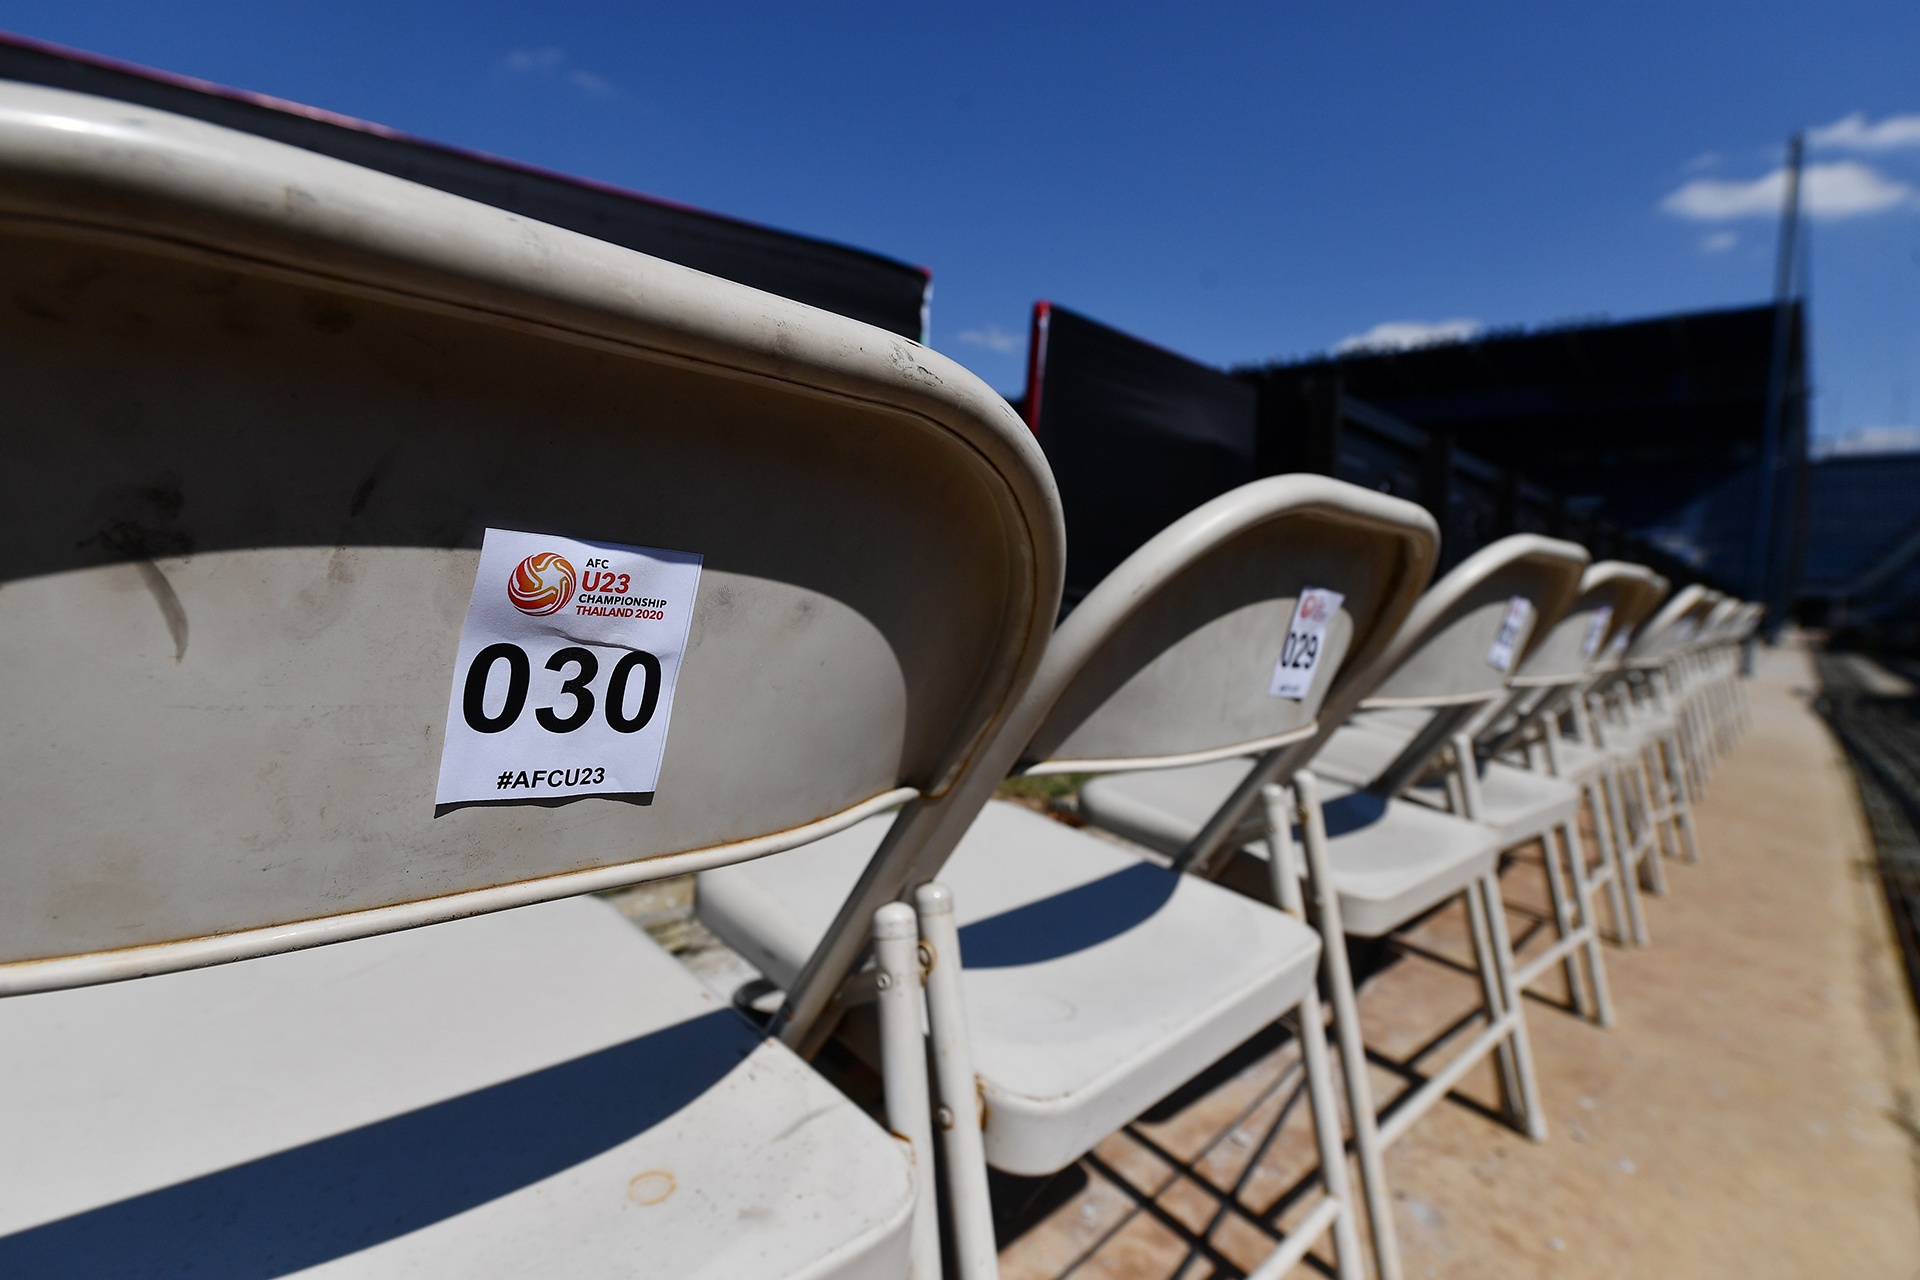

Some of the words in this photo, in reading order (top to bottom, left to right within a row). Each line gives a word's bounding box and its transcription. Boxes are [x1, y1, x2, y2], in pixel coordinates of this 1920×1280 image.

[586, 558, 609, 569] AFC
[582, 571, 630, 593] U23
[579, 594, 667, 608] CHAMPIONSHIP
[576, 606, 633, 617] THAILAND
[635, 609, 664, 620] 2020
[1281, 633, 1318, 669] 029
[463, 643, 661, 733] 030
[497, 767, 605, 790] #AFCU23
